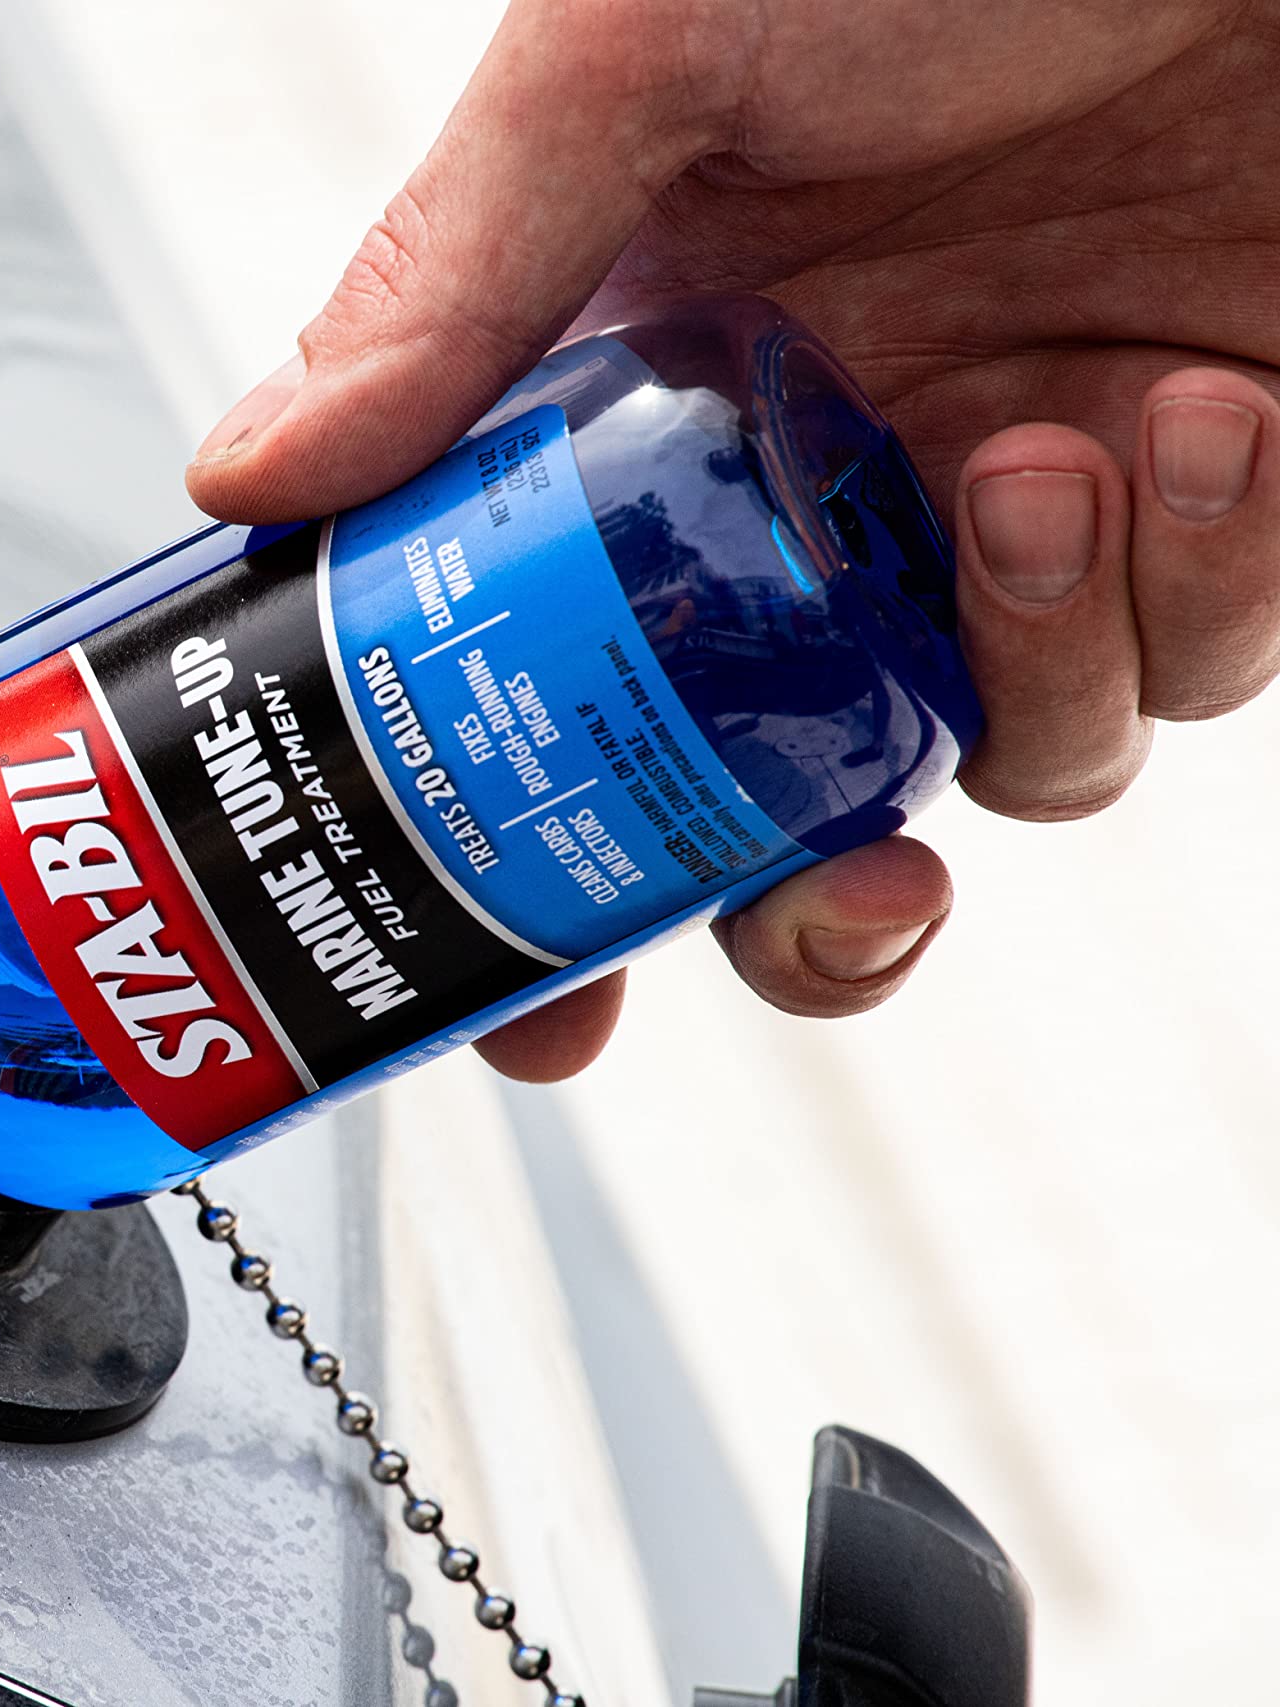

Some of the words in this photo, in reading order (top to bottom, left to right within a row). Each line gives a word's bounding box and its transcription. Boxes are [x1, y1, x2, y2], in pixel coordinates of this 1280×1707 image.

[477, 448, 496, 467] OZ
[499, 435, 520, 462] mL)
[520, 426, 541, 451] 921
[481, 465, 498, 477] 8
[483, 478, 503, 504] WT
[503, 460, 527, 492] (236
[526, 452, 551, 493] 22313
[488, 499, 511, 528] NET
[403, 537, 454, 634] ELIMINATES
[436, 537, 475, 602] WATER
[358, 647, 434, 768] GALLONS
[504, 671, 560, 748] ENGINES
[576, 702, 598, 718] IF
[622, 676, 649, 708] back
[644, 707, 660, 723] on
[453, 713, 496, 764] FIXES
[458, 648, 552, 796] ROUGH-RUNNING
[587, 714, 621, 760] FATAL
[171, 636, 299, 862] TUNE-UP
[255, 671, 363, 864] TREATMENT
[612, 763, 636, 780] OR
[625, 727, 691, 816] COMBUSTIBLE.
[651, 721, 705, 785] precautions
[415, 767, 457, 807] 20
[625, 777, 671, 833] HARMFUL
[698, 783, 721, 808] other
[440, 802, 500, 875] TREATS
[534, 816, 584, 864] CARBS
[568, 808, 637, 876] INJECTORS
[664, 826, 723, 884] DANGER:
[567, 860, 620, 904] CLEANS
[621, 869, 646, 886] &
[1, 729, 252, 1078] STA-BIL
[356, 868, 418, 940] FUEL
[260, 850, 418, 1021] MARINE
